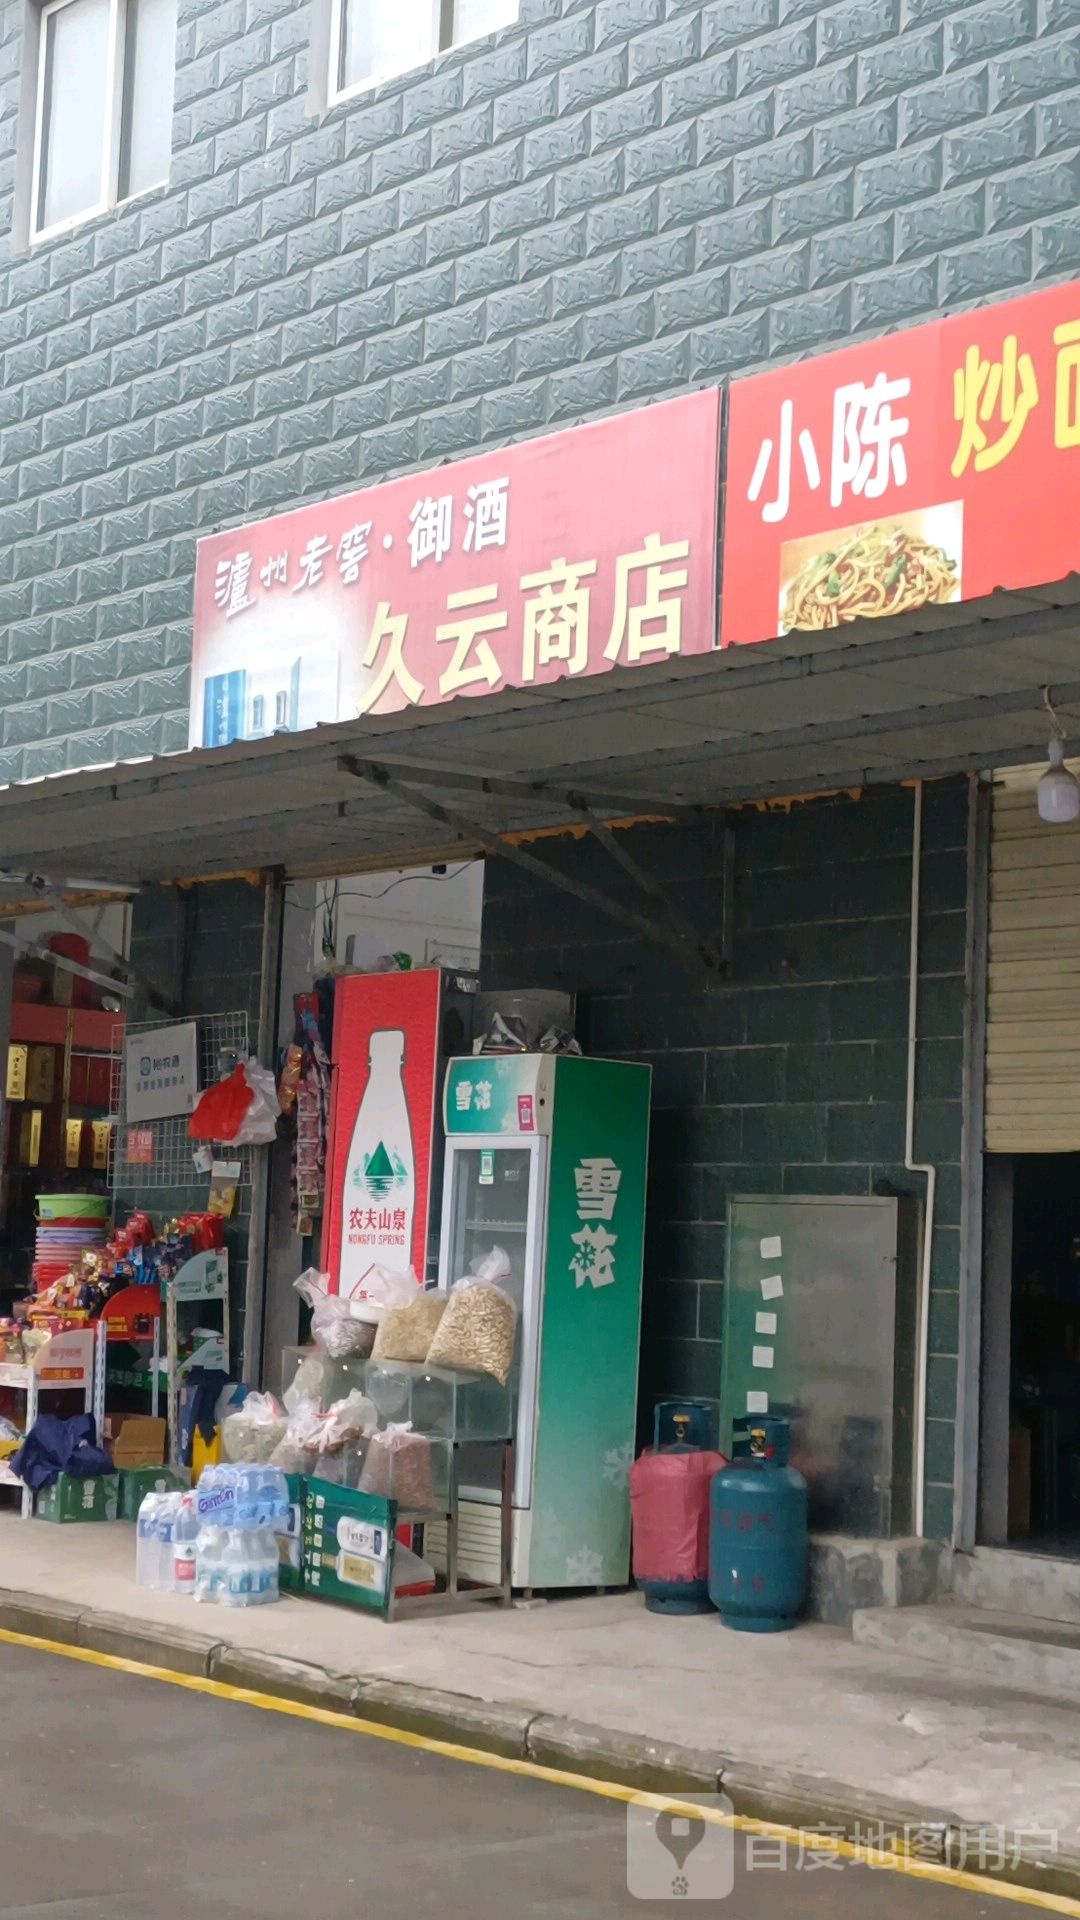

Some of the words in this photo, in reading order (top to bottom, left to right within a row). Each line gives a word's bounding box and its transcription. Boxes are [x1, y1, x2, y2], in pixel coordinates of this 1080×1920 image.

[355, 533, 690, 712] 久云商店
[348, 1234, 376, 1245] NONGFU
[378, 1234, 406, 1246] SPRING
[349, 1207, 407, 1230] 农夫山泉
[567, 1158, 622, 1289] 雪花
